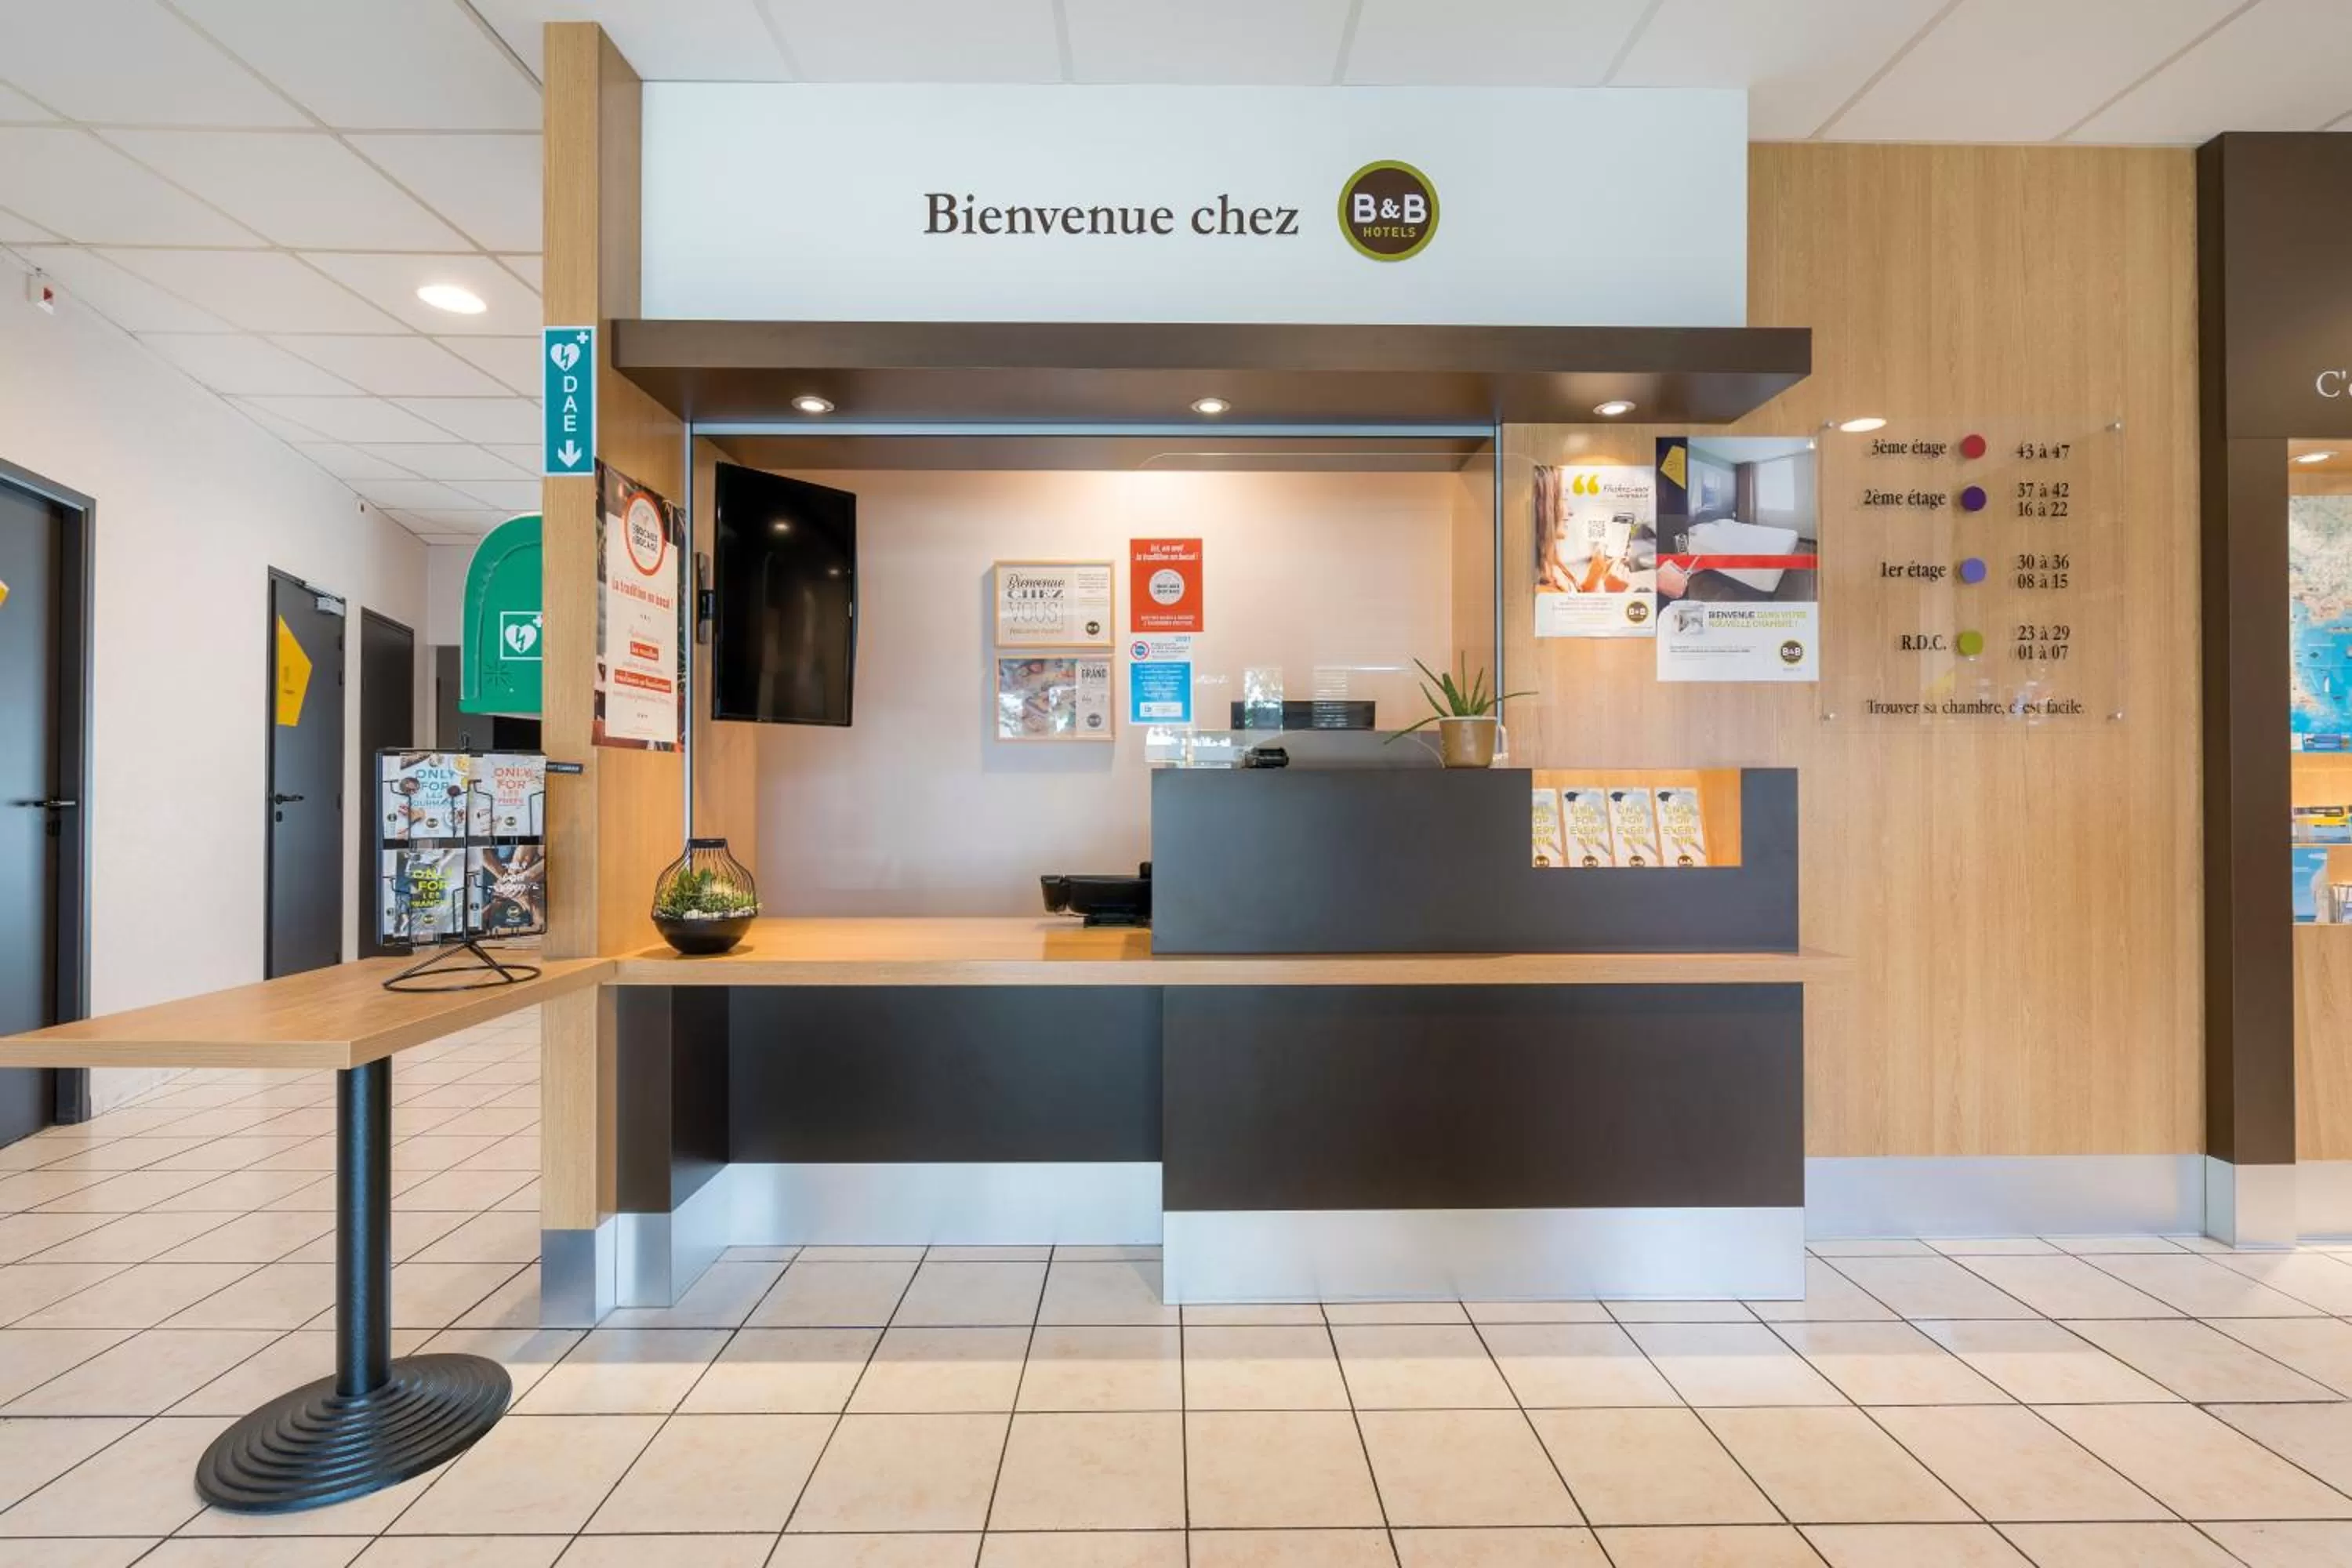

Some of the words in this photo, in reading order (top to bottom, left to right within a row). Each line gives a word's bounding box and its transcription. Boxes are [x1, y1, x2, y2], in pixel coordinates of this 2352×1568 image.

[923, 192, 1174, 235] Bienvenue
[1190, 194, 1300, 235] chez
[1353, 193, 1428, 224] B&B
[1363, 227, 1417, 238] HOTELS
[2315, 370, 2352, 398] C'
[563, 376, 578, 432] DAE
[1871, 439, 1907, 456] 3ème
[1911, 439, 1947, 458] étage
[2016, 444, 2034, 459] 43
[2039, 443, 2048, 458] à
[2052, 444, 2071, 459] 47
[2017, 483, 2034, 498] 37
[2039, 481, 2048, 498] à
[2052, 483, 2070, 498] 42
[1864, 489, 1904, 506] 2ème
[1907, 489, 1947, 508] étage
[2018, 501, 2033, 517] 16
[2051, 501, 2068, 517] 22
[2017, 554, 2034, 569] 30
[2040, 554, 2048, 569] à
[2053, 554, 2070, 570] 36
[1881, 561, 1904, 578] 1er
[1908, 561, 1947, 582] étage
[2017, 573, 2034, 589] 08
[2039, 572, 2048, 588] à
[2053, 573, 2068, 589] 15
[2017, 626, 2035, 641] 23
[2040, 625, 2048, 641] à
[2053, 626, 2071, 641] 29
[1901, 634, 1947, 651] R.D.C.
[2018, 645, 2034, 659] 01
[2039, 644, 2047, 659] à
[2052, 645, 2069, 659] 07
[1866, 699, 1919, 714] Trouver
[1923, 703, 1937, 714] sa
[1942, 699, 2005, 716] chambre,
[2046, 699, 2084, 714] facile.
[416, 769, 456, 779] ONLY
